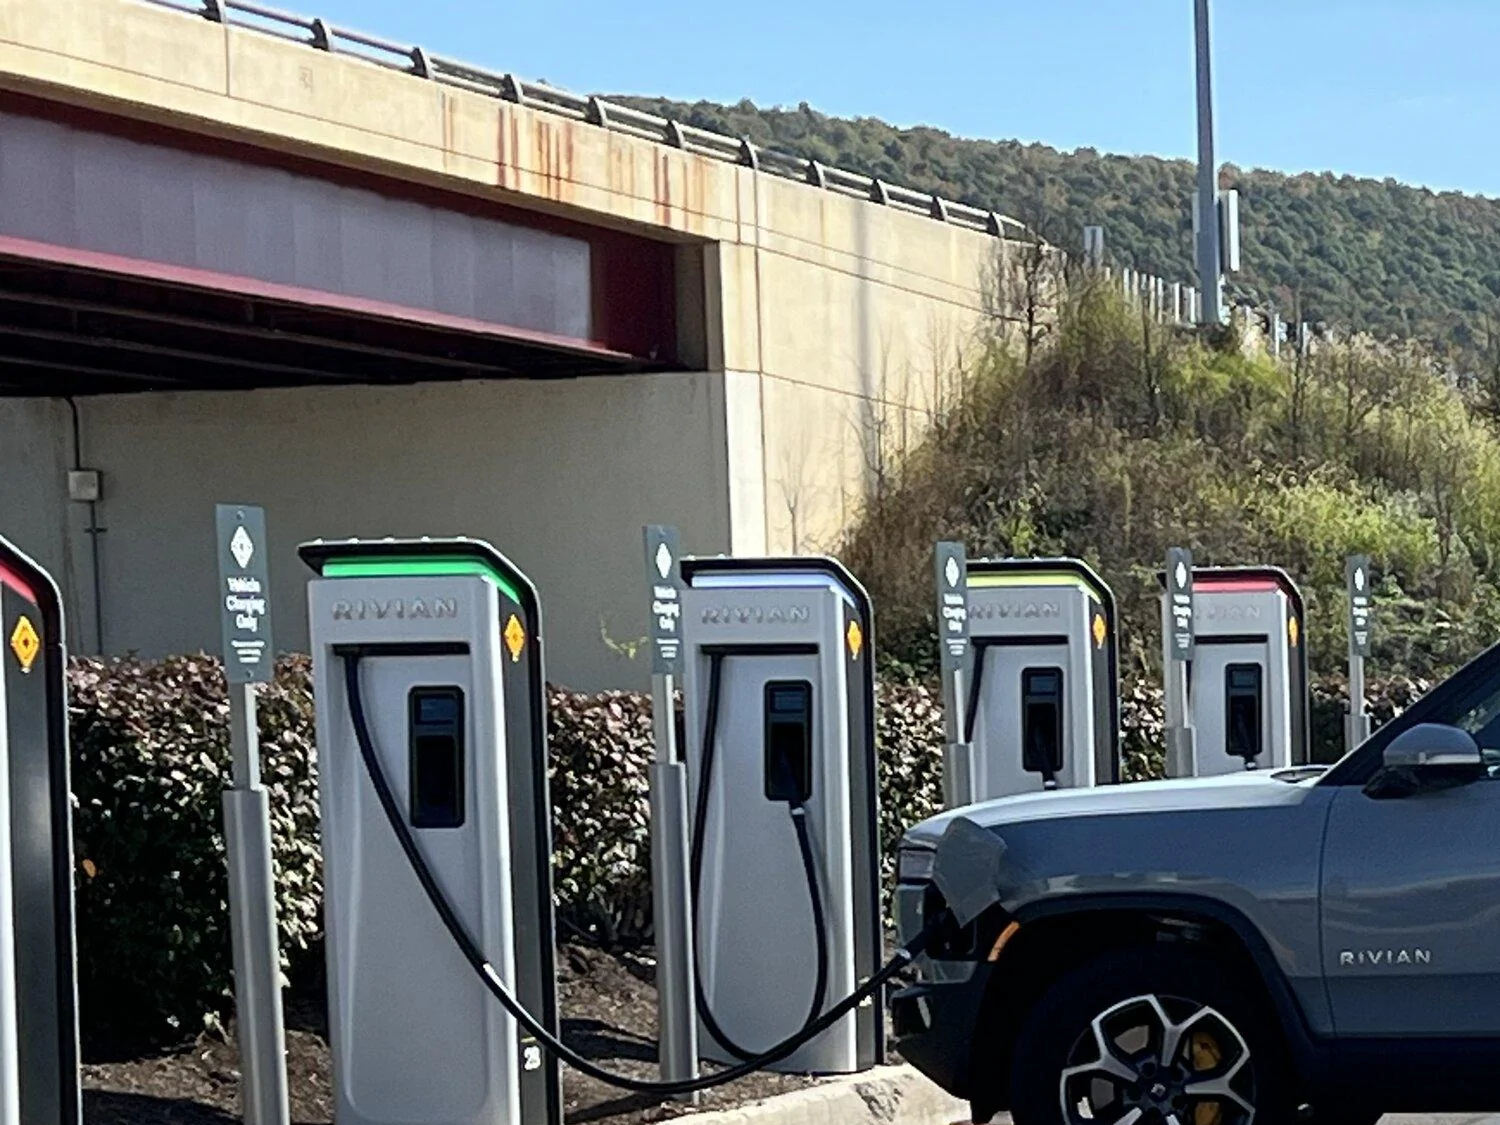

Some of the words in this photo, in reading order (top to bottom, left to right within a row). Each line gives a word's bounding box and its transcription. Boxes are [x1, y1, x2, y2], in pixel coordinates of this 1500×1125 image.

[331, 598, 458, 620] RIVIAN
[700, 605, 810, 624] RIVIAN
[966, 602, 1060, 619] RIVIAN
[1340, 949, 1431, 966] RIVIAN
